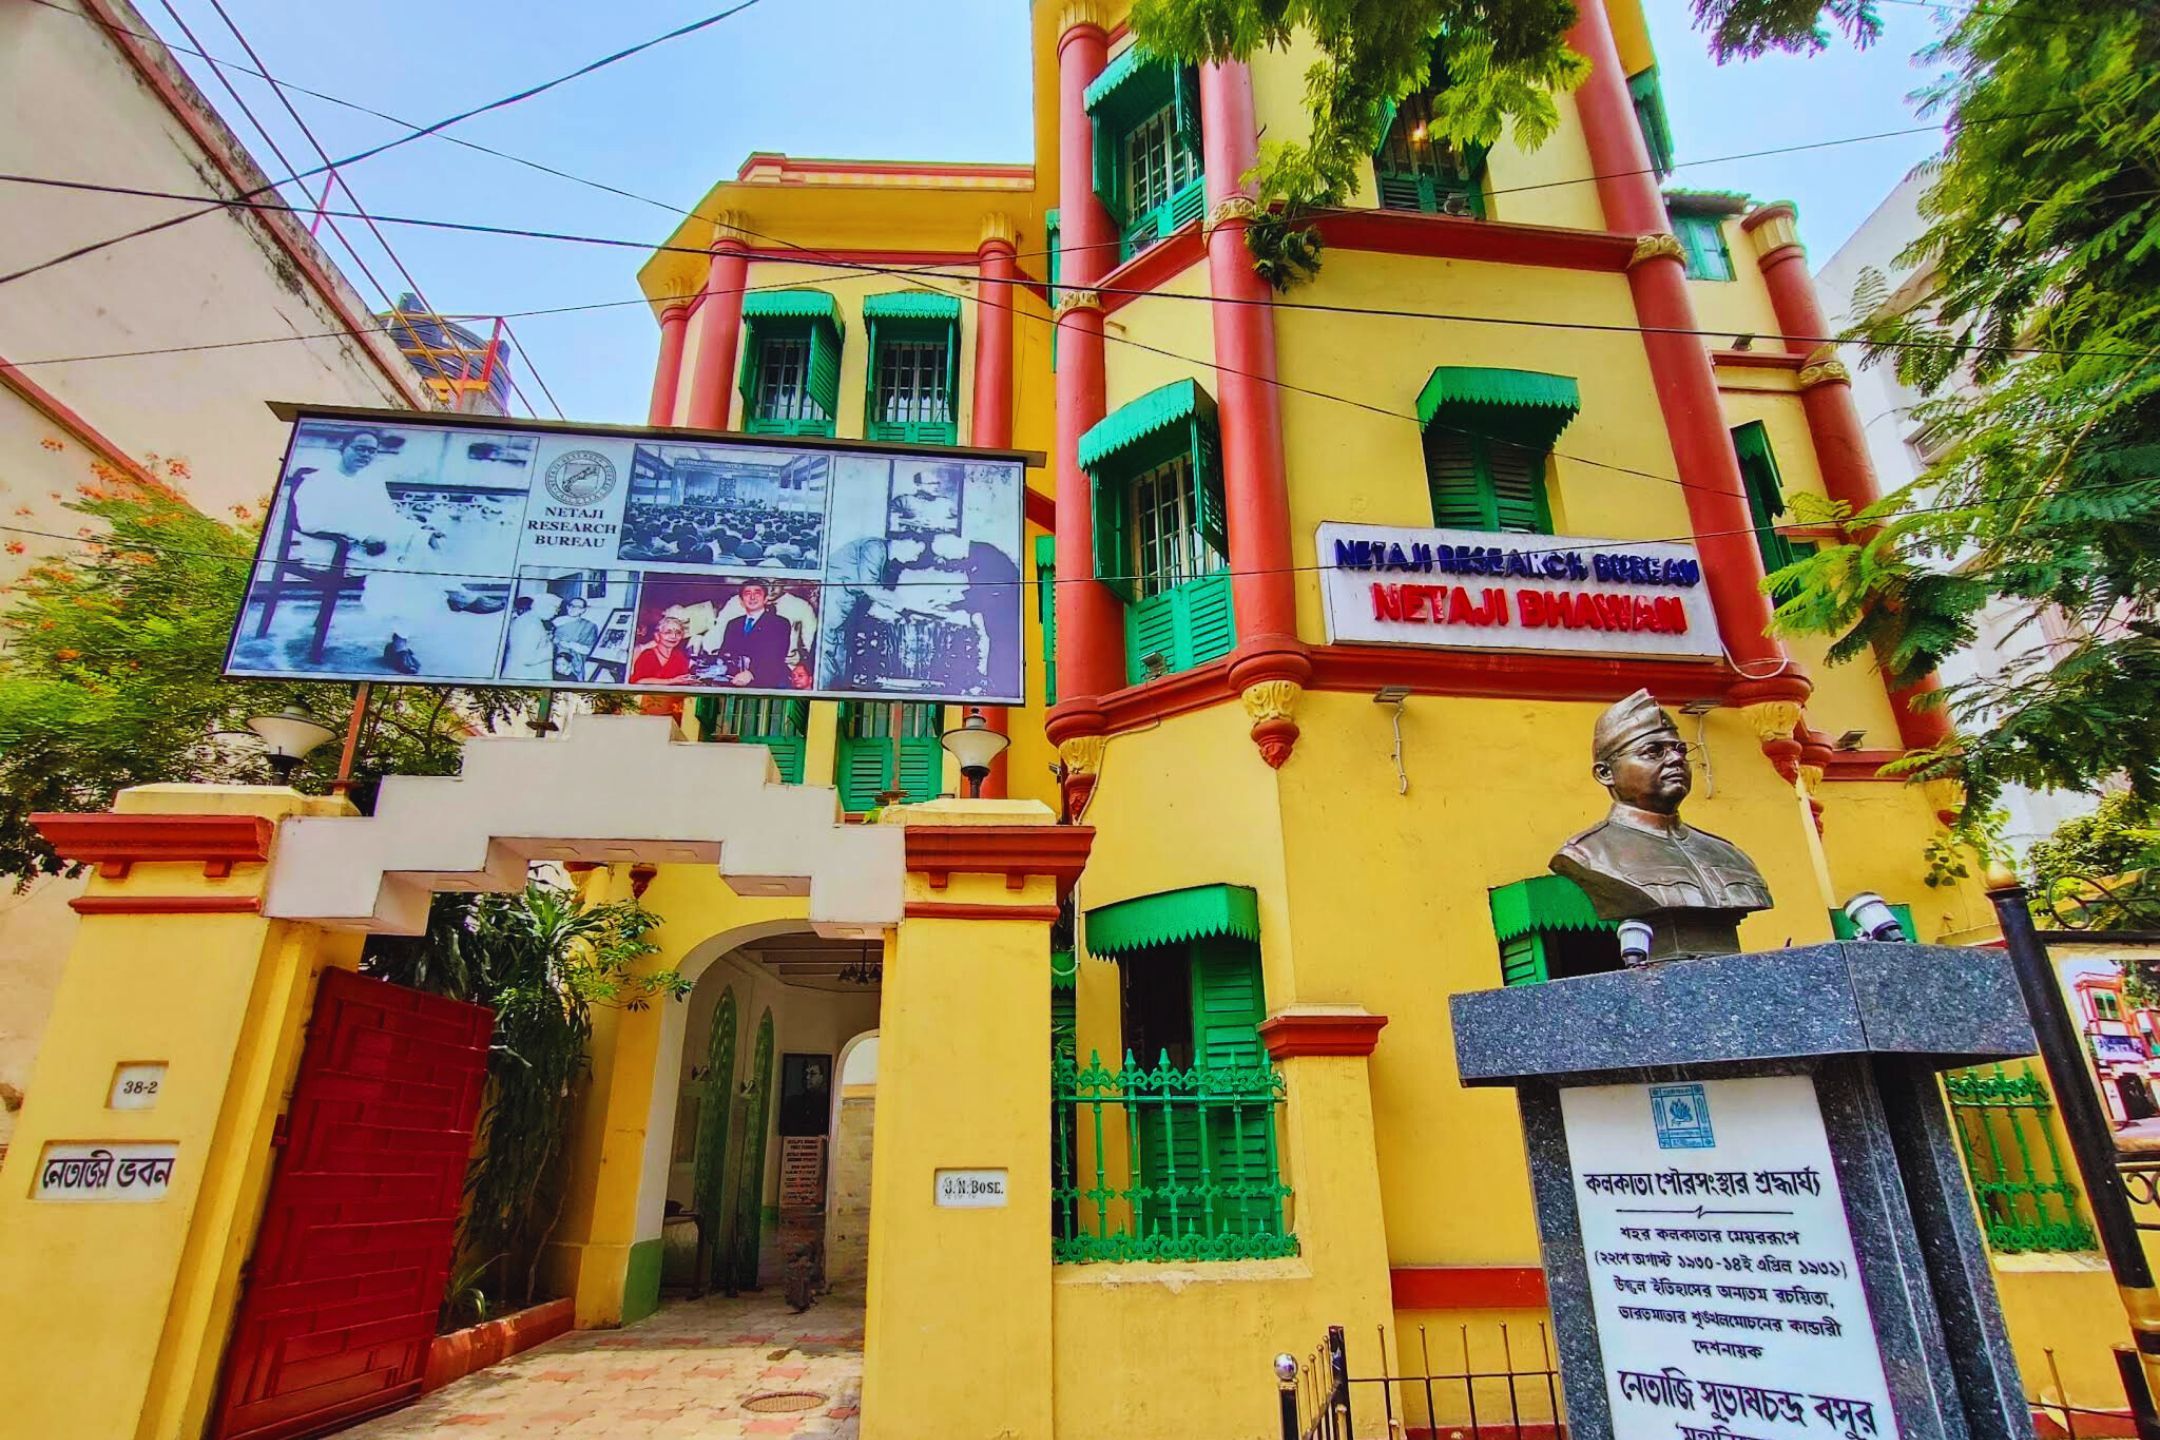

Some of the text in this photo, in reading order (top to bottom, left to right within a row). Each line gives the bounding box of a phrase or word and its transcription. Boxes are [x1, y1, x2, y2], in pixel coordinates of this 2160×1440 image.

[545, 507, 604, 519] NETAJI
[527, 520, 617, 534] RESEARCH
[535, 534, 606, 548] BUREAU
[1334, 539, 1700, 587] NETAJI RESEARCH BUREAU
[1371, 582, 1688, 635] NETAJI BHAWAN
[123, 1080, 158, 1095] 38-2
[42, 1149, 176, 1189] নেতাজী ভবন
[1583, 1165, 1821, 1197] কলকাতা পৌরসংস্থার শ্রদ্ধার্ঘ্য
[1620, 1227, 1650, 1241] শহর
[1656, 1228, 1722, 1244] কলকাতার
[1594, 1250, 1630, 1266] (২২শে
[1757, 1257, 1793, 1275] এপ্রিল
[1798, 1260, 1848, 1280] ১৯৩১)
[1650, 1277, 1712, 1298] ইতিহাসের
[1716, 1284, 1768, 1302] অন্যতম
[1618, 1305, 1686, 1324] ভারতমাতার
[1617, 1366, 1878, 1440] নেতাজি সুভাষচন্দ্র বসুর
